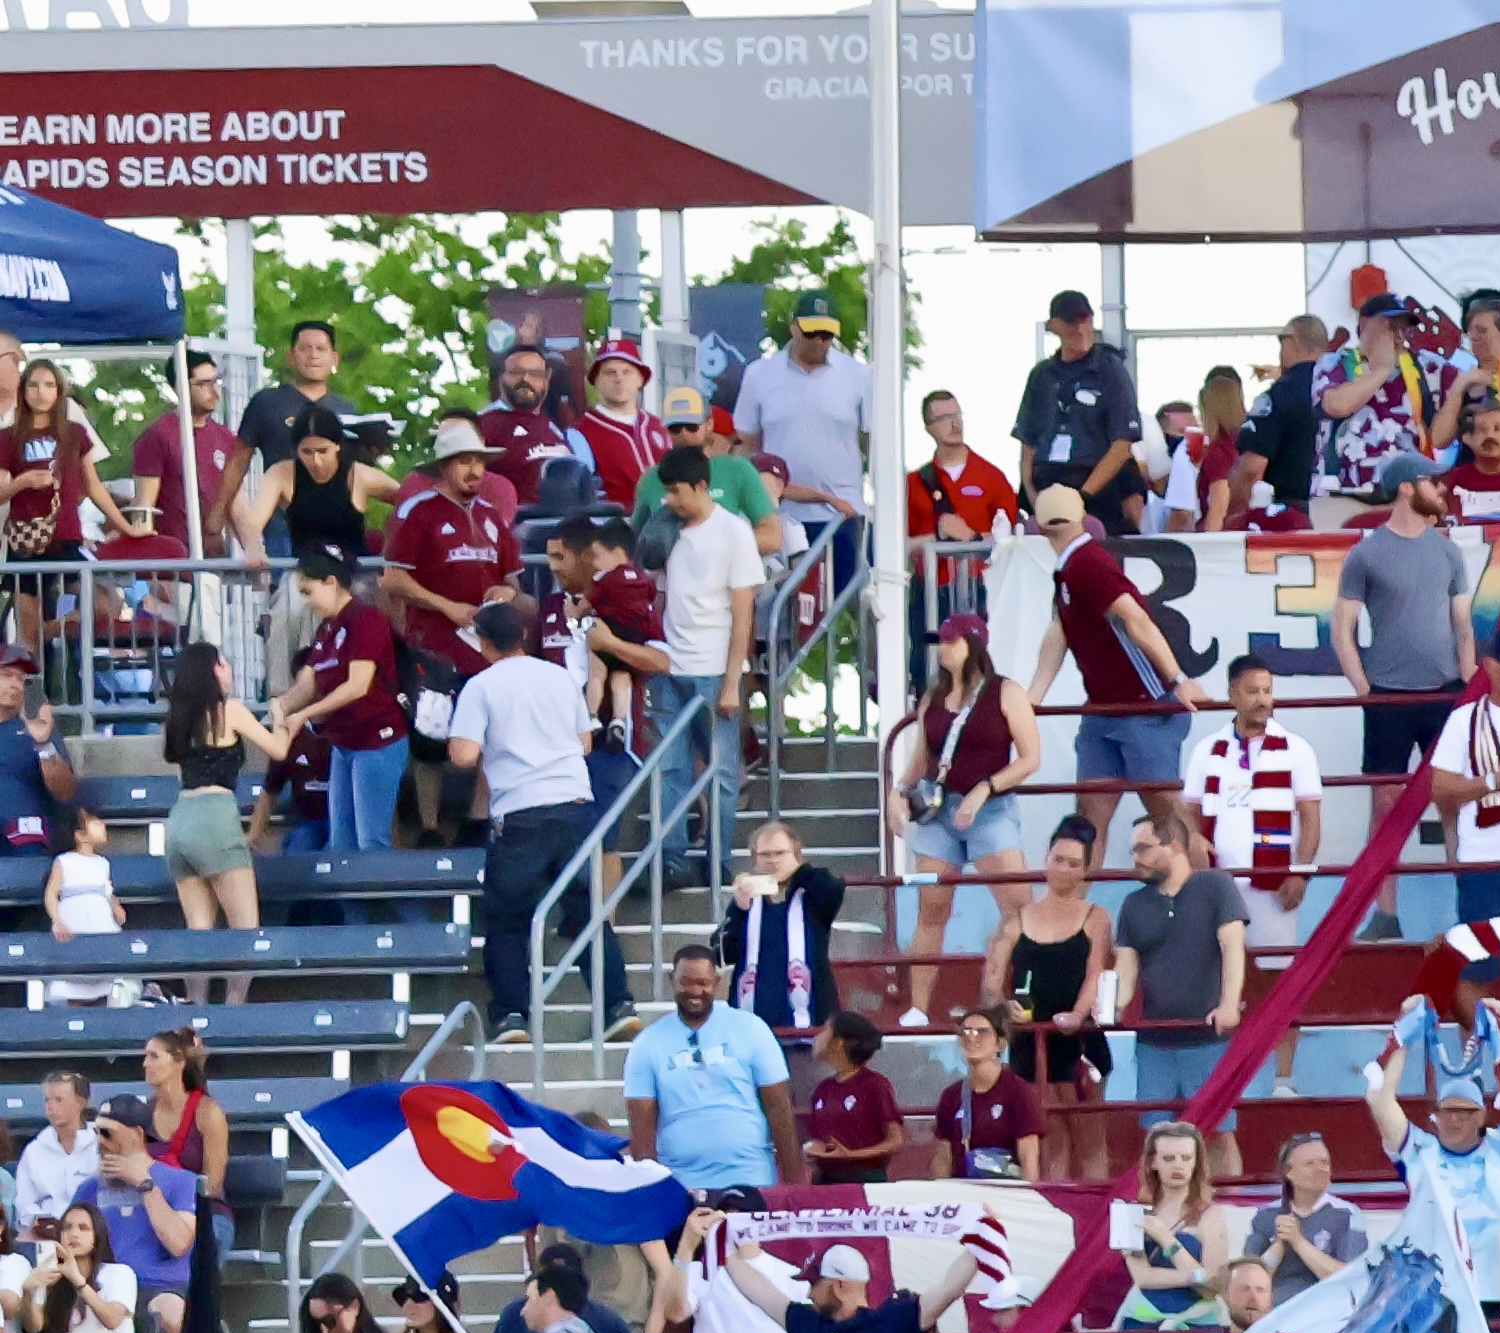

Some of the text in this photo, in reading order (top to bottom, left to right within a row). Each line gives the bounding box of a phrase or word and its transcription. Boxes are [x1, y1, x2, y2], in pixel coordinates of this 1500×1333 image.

[580, 39, 725, 69] THANKS
[736, 34, 807, 67] FOR
[805, 35, 919, 67] YOR
[105, 112, 210, 145] MORE
[221, 110, 345, 143] ABOUT
[119, 155, 267, 188] SEASON
[277, 151, 428, 186] TICKETS
